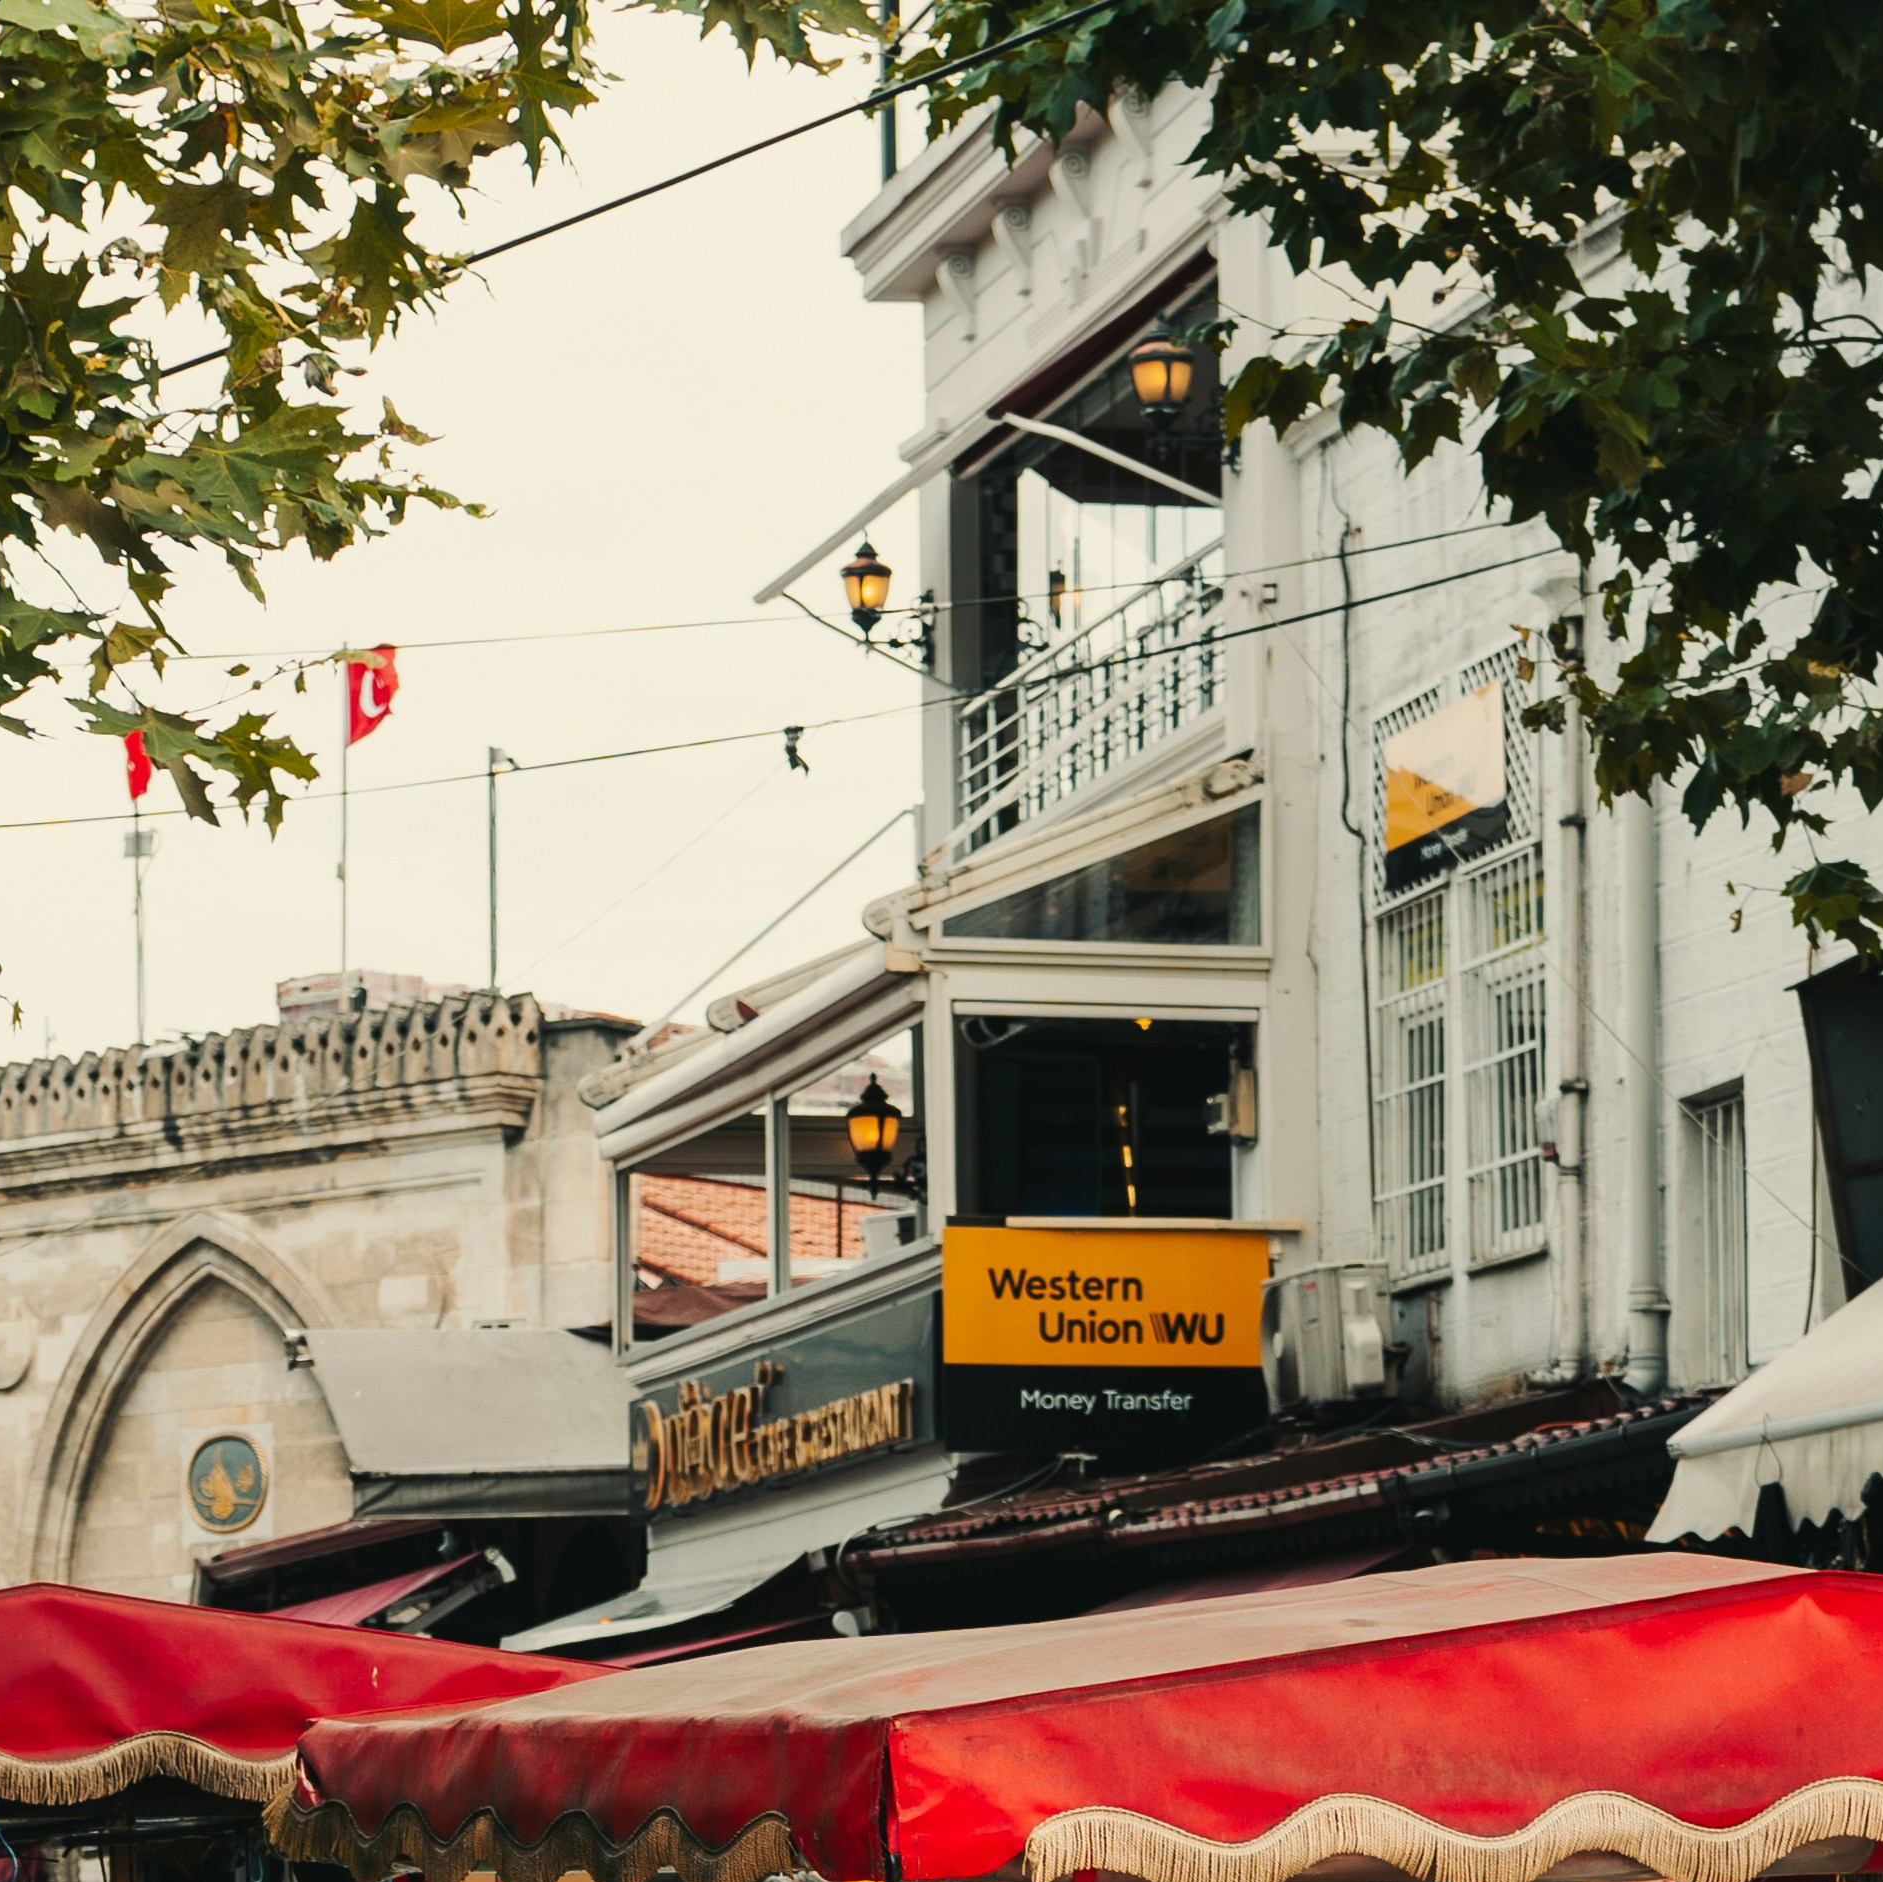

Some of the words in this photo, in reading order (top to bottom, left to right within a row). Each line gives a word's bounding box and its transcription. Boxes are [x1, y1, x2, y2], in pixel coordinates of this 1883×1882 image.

[987, 1267, 1143, 1302] Western
[1038, 1309, 1144, 1345] Union
[1151, 1312, 1225, 1346] WU
[815, 1378, 915, 1462] RESTAURANT
[1020, 1389, 1096, 1416] Money
[1103, 1388, 1194, 1411] Transfer
